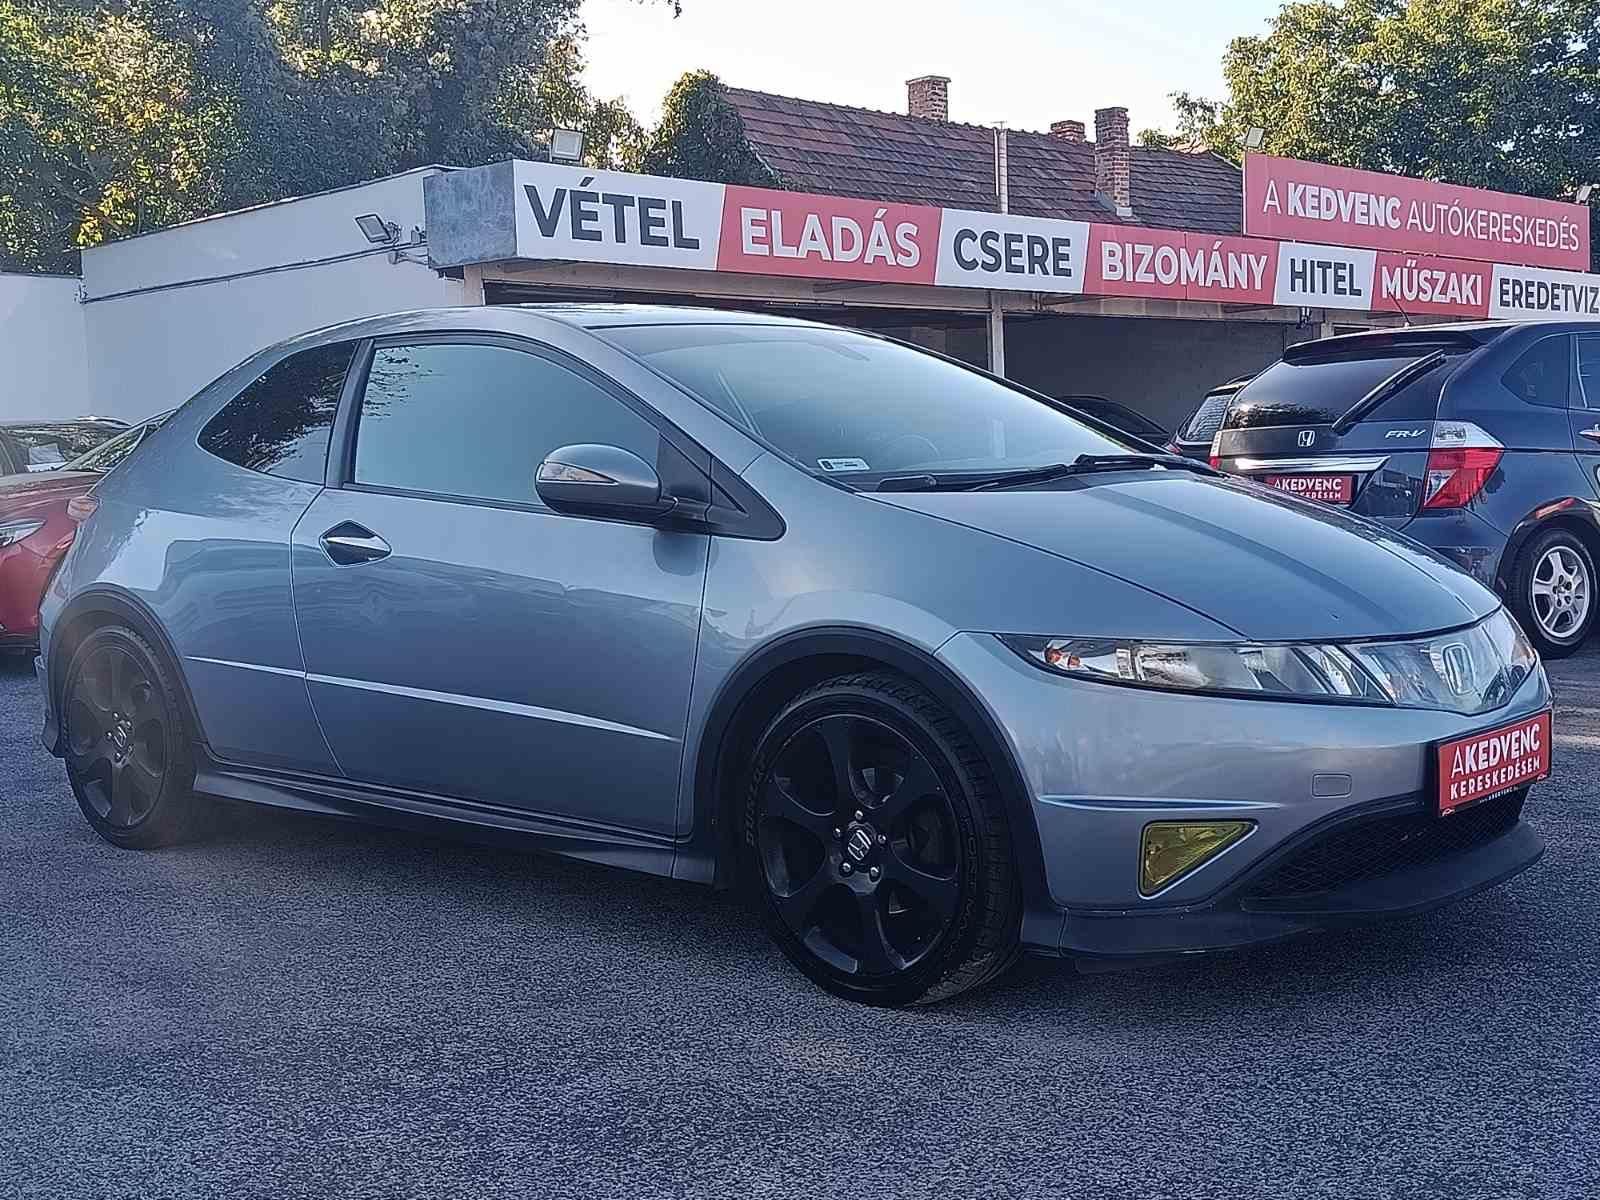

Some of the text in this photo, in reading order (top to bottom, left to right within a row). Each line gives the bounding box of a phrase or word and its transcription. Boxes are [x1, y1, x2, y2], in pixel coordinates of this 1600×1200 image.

[523, 175, 1600, 314] VÉTEL ELADÁS CSERE BIZOMÁNY HITEL MŰSZAKI EREDETVIZ
[1263, 179, 1579, 251] A KEDVENC AUTÓKERESKEDÉS
[1450, 755, 1541, 800] KERESKEDÉSEM
